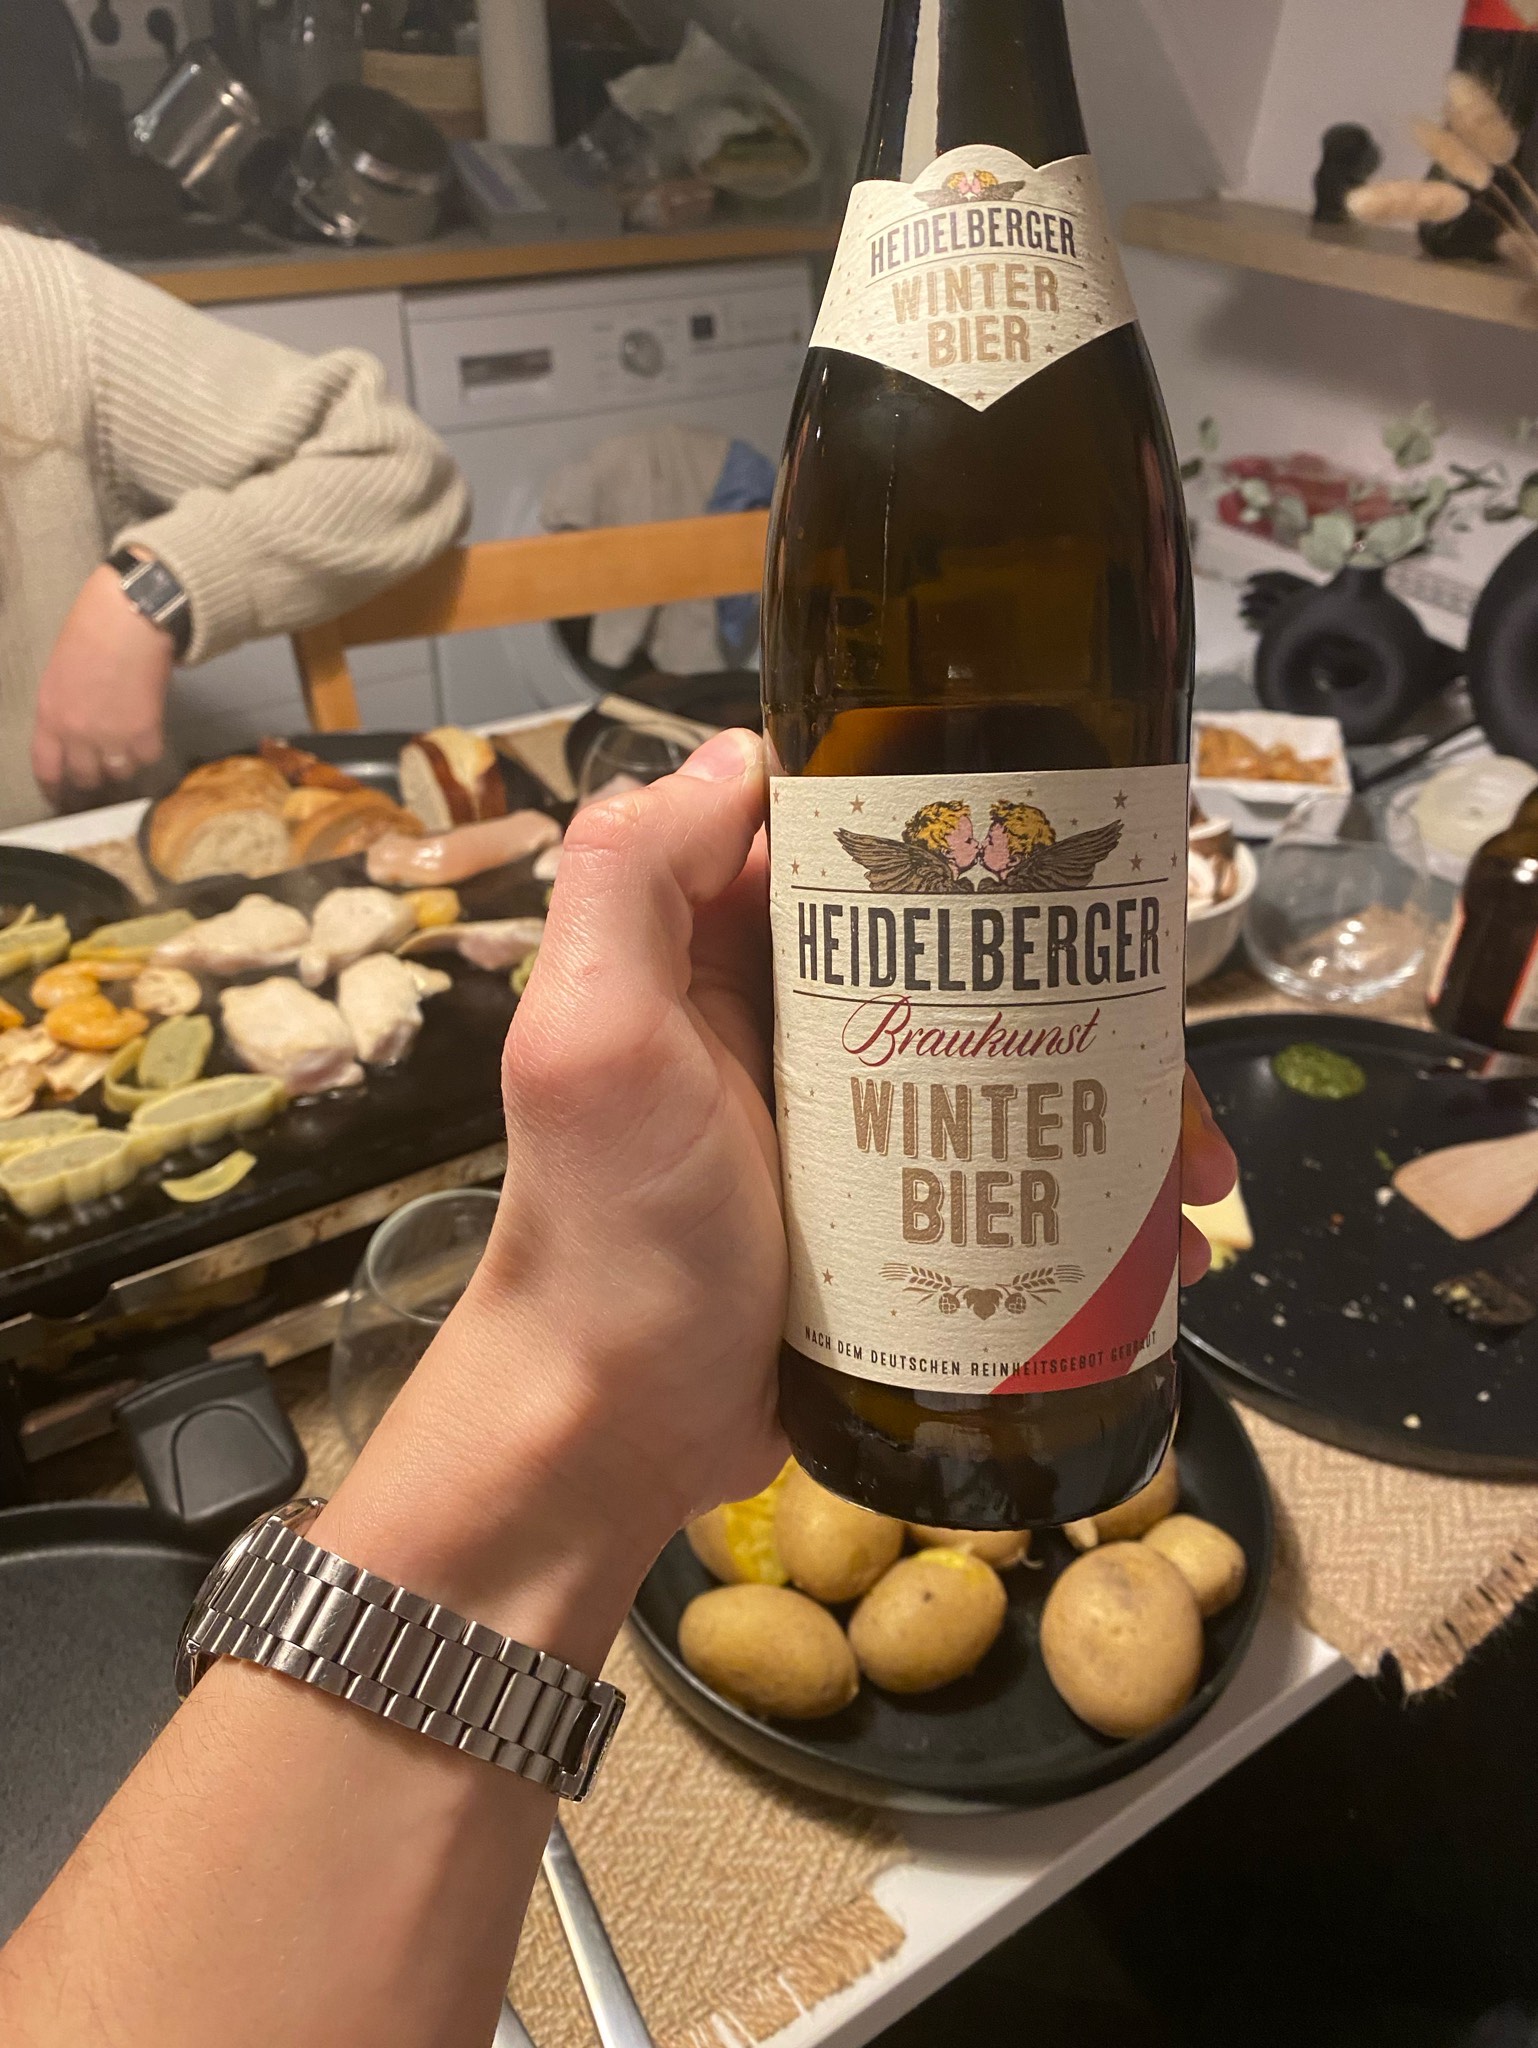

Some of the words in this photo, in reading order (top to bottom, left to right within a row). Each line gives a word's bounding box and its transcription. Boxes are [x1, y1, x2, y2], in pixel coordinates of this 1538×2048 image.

[870, 207, 1076, 278] HEIDELBERGER
[892, 263, 1060, 325] WINTER
[927, 315, 1031, 368] BIER
[798, 896, 1160, 992] HEIDELBERGER
[841, 994, 1100, 1067] Braukunst
[850, 1076, 1109, 1162] WINTER
[901, 1167, 1060, 1248] BIER
[805, 1326, 832, 1350] NACH
[838, 1340, 863, 1360] DEM
[871, 1350, 961, 1376] DEUTSCHEN
[971, 1351, 1104, 1377] REINHEITSGEBOT
